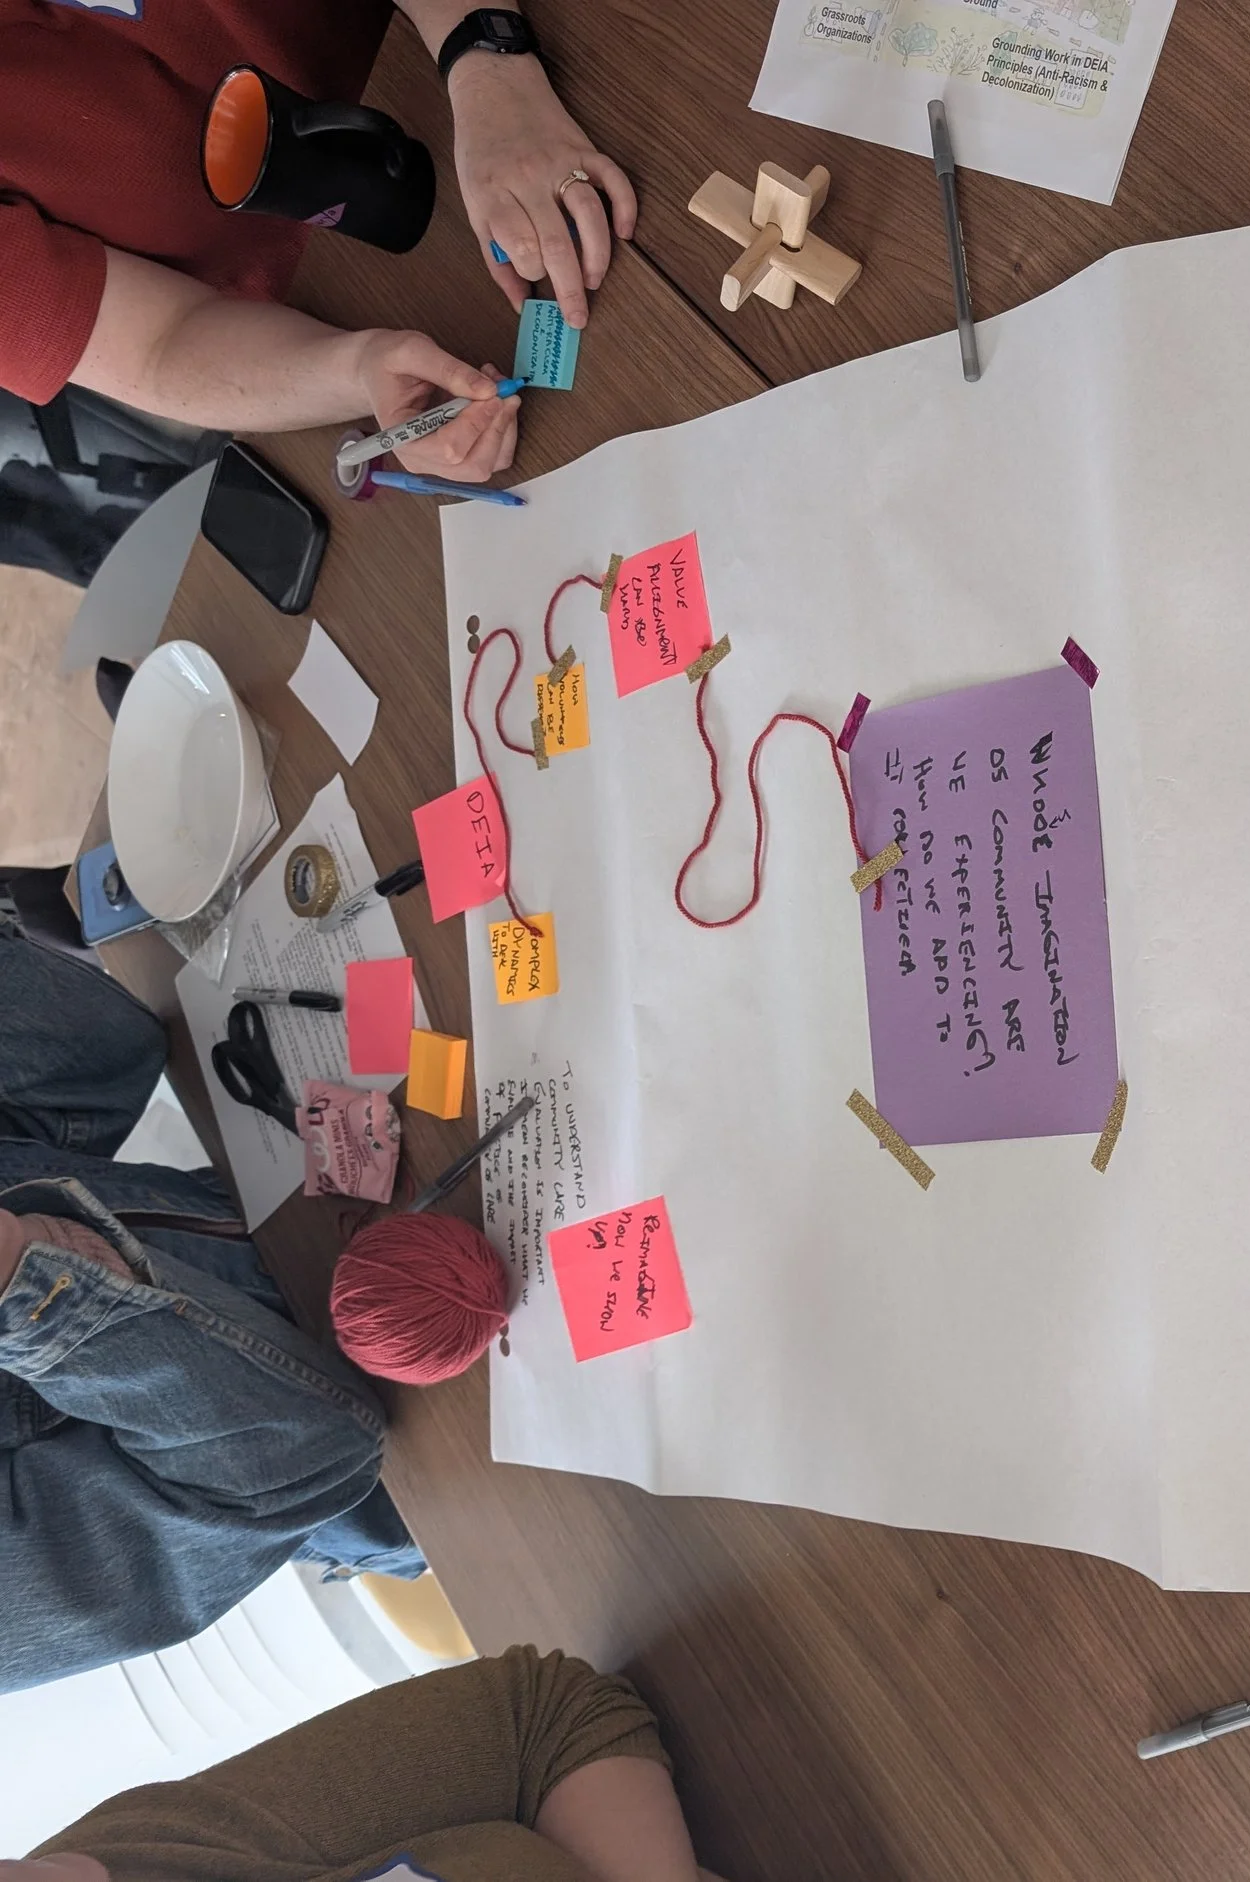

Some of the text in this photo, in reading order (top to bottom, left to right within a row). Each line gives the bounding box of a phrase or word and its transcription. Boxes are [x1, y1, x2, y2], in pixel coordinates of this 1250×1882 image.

[816, 23, 873, 45] Organizations
[821, 6, 866, 26] Grassroots
[986, 54, 1108, 92] Principles (Anti-Racism &
[991, 37, 1109, 73] Grounding Work in DEIA
[981, 71, 1055, 100] Decolonization)
[619, 584, 631, 630] HARD
[632, 577, 644, 607] CAN
[670, 548, 688, 608] VALUE
[467, 791, 494, 878] DEIA
[992, 809, 1025, 1052] COMMUNITY ARE
[506, 926, 526, 996] DYNAMICS
[528, 934, 541, 992] OMPLEX
[1035, 870, 1080, 1066] IMAGINATION
[548, 1078, 565, 1221] COMMUNITY CARE
[565, 1104, 586, 1210] UNDERSTAND
[533, 1209, 544, 1286] IMPORTANT
